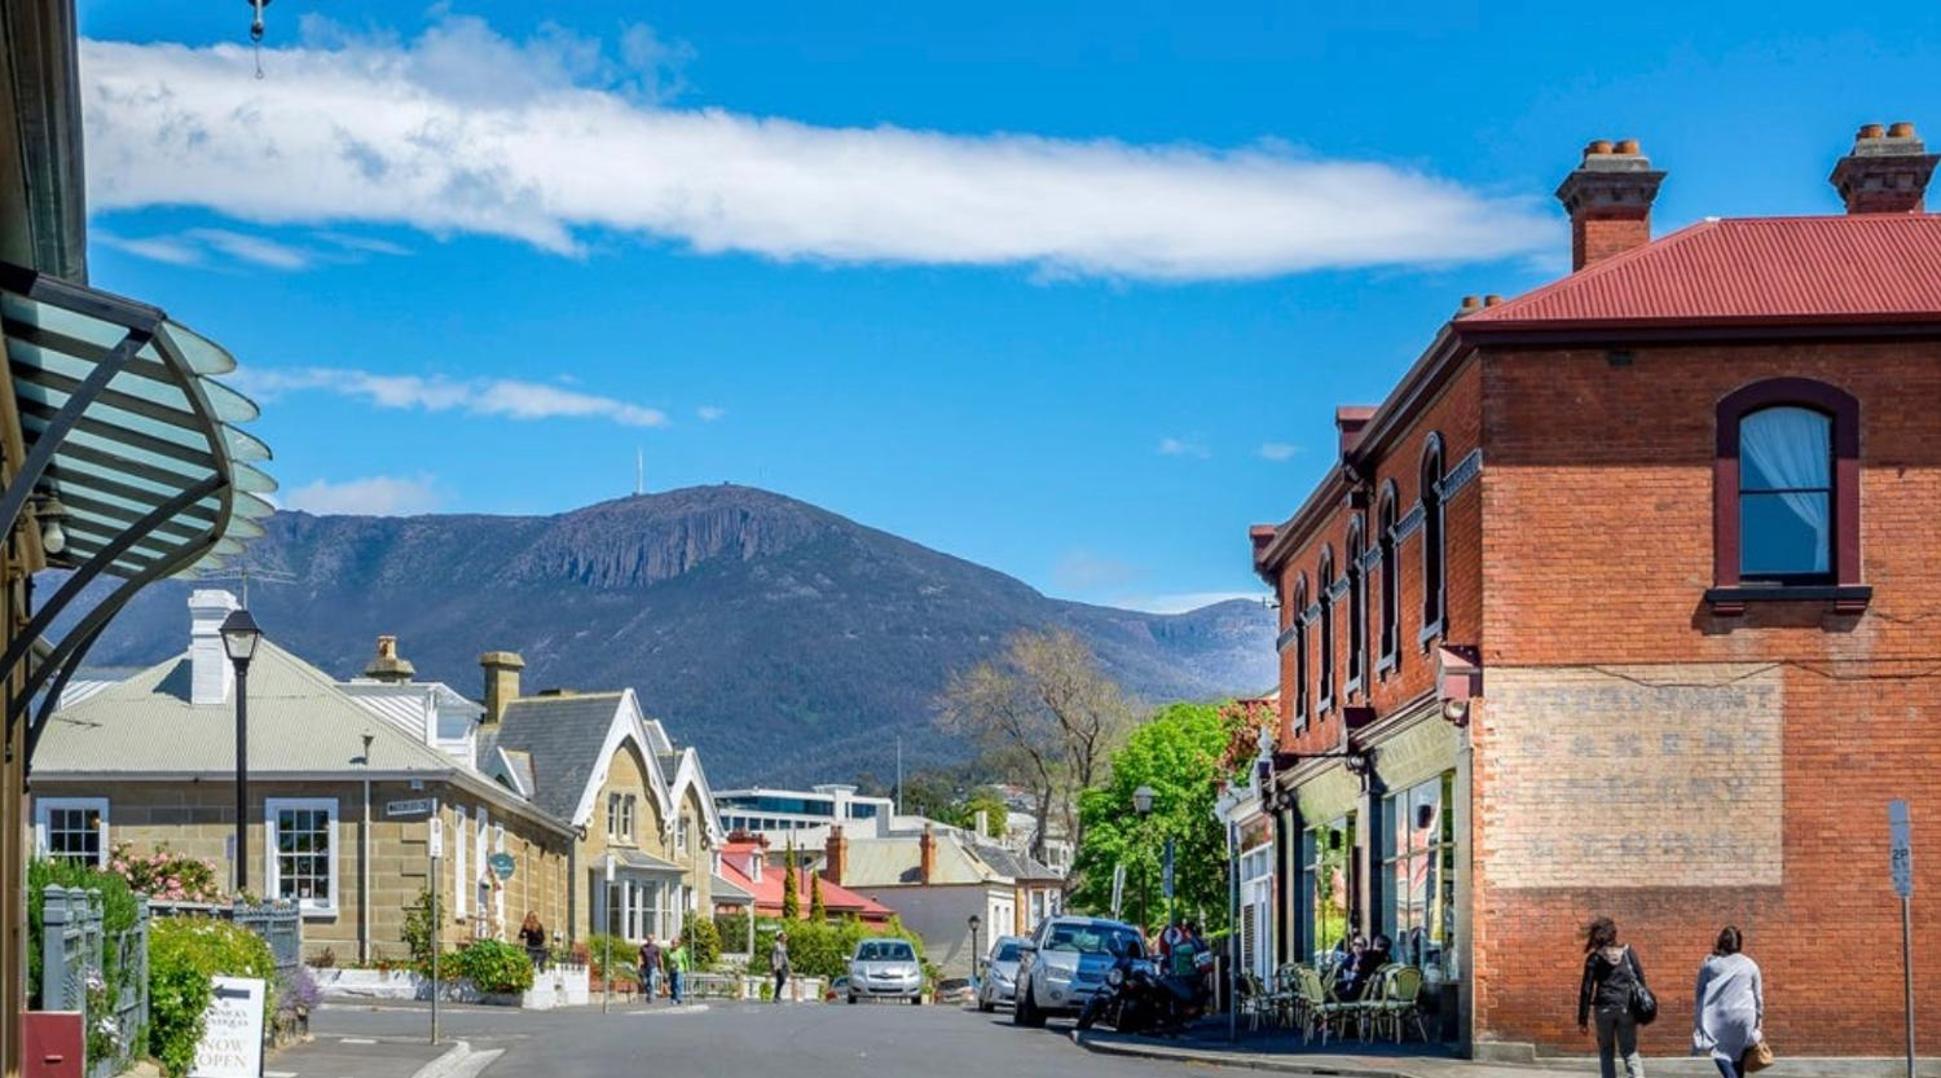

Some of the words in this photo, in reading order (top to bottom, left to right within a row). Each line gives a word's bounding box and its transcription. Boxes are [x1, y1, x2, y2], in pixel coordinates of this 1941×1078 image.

[1892, 848, 1909, 860] 2P
[202, 1037, 247, 1052] NOW
[198, 1052, 248, 1068] OPEN
